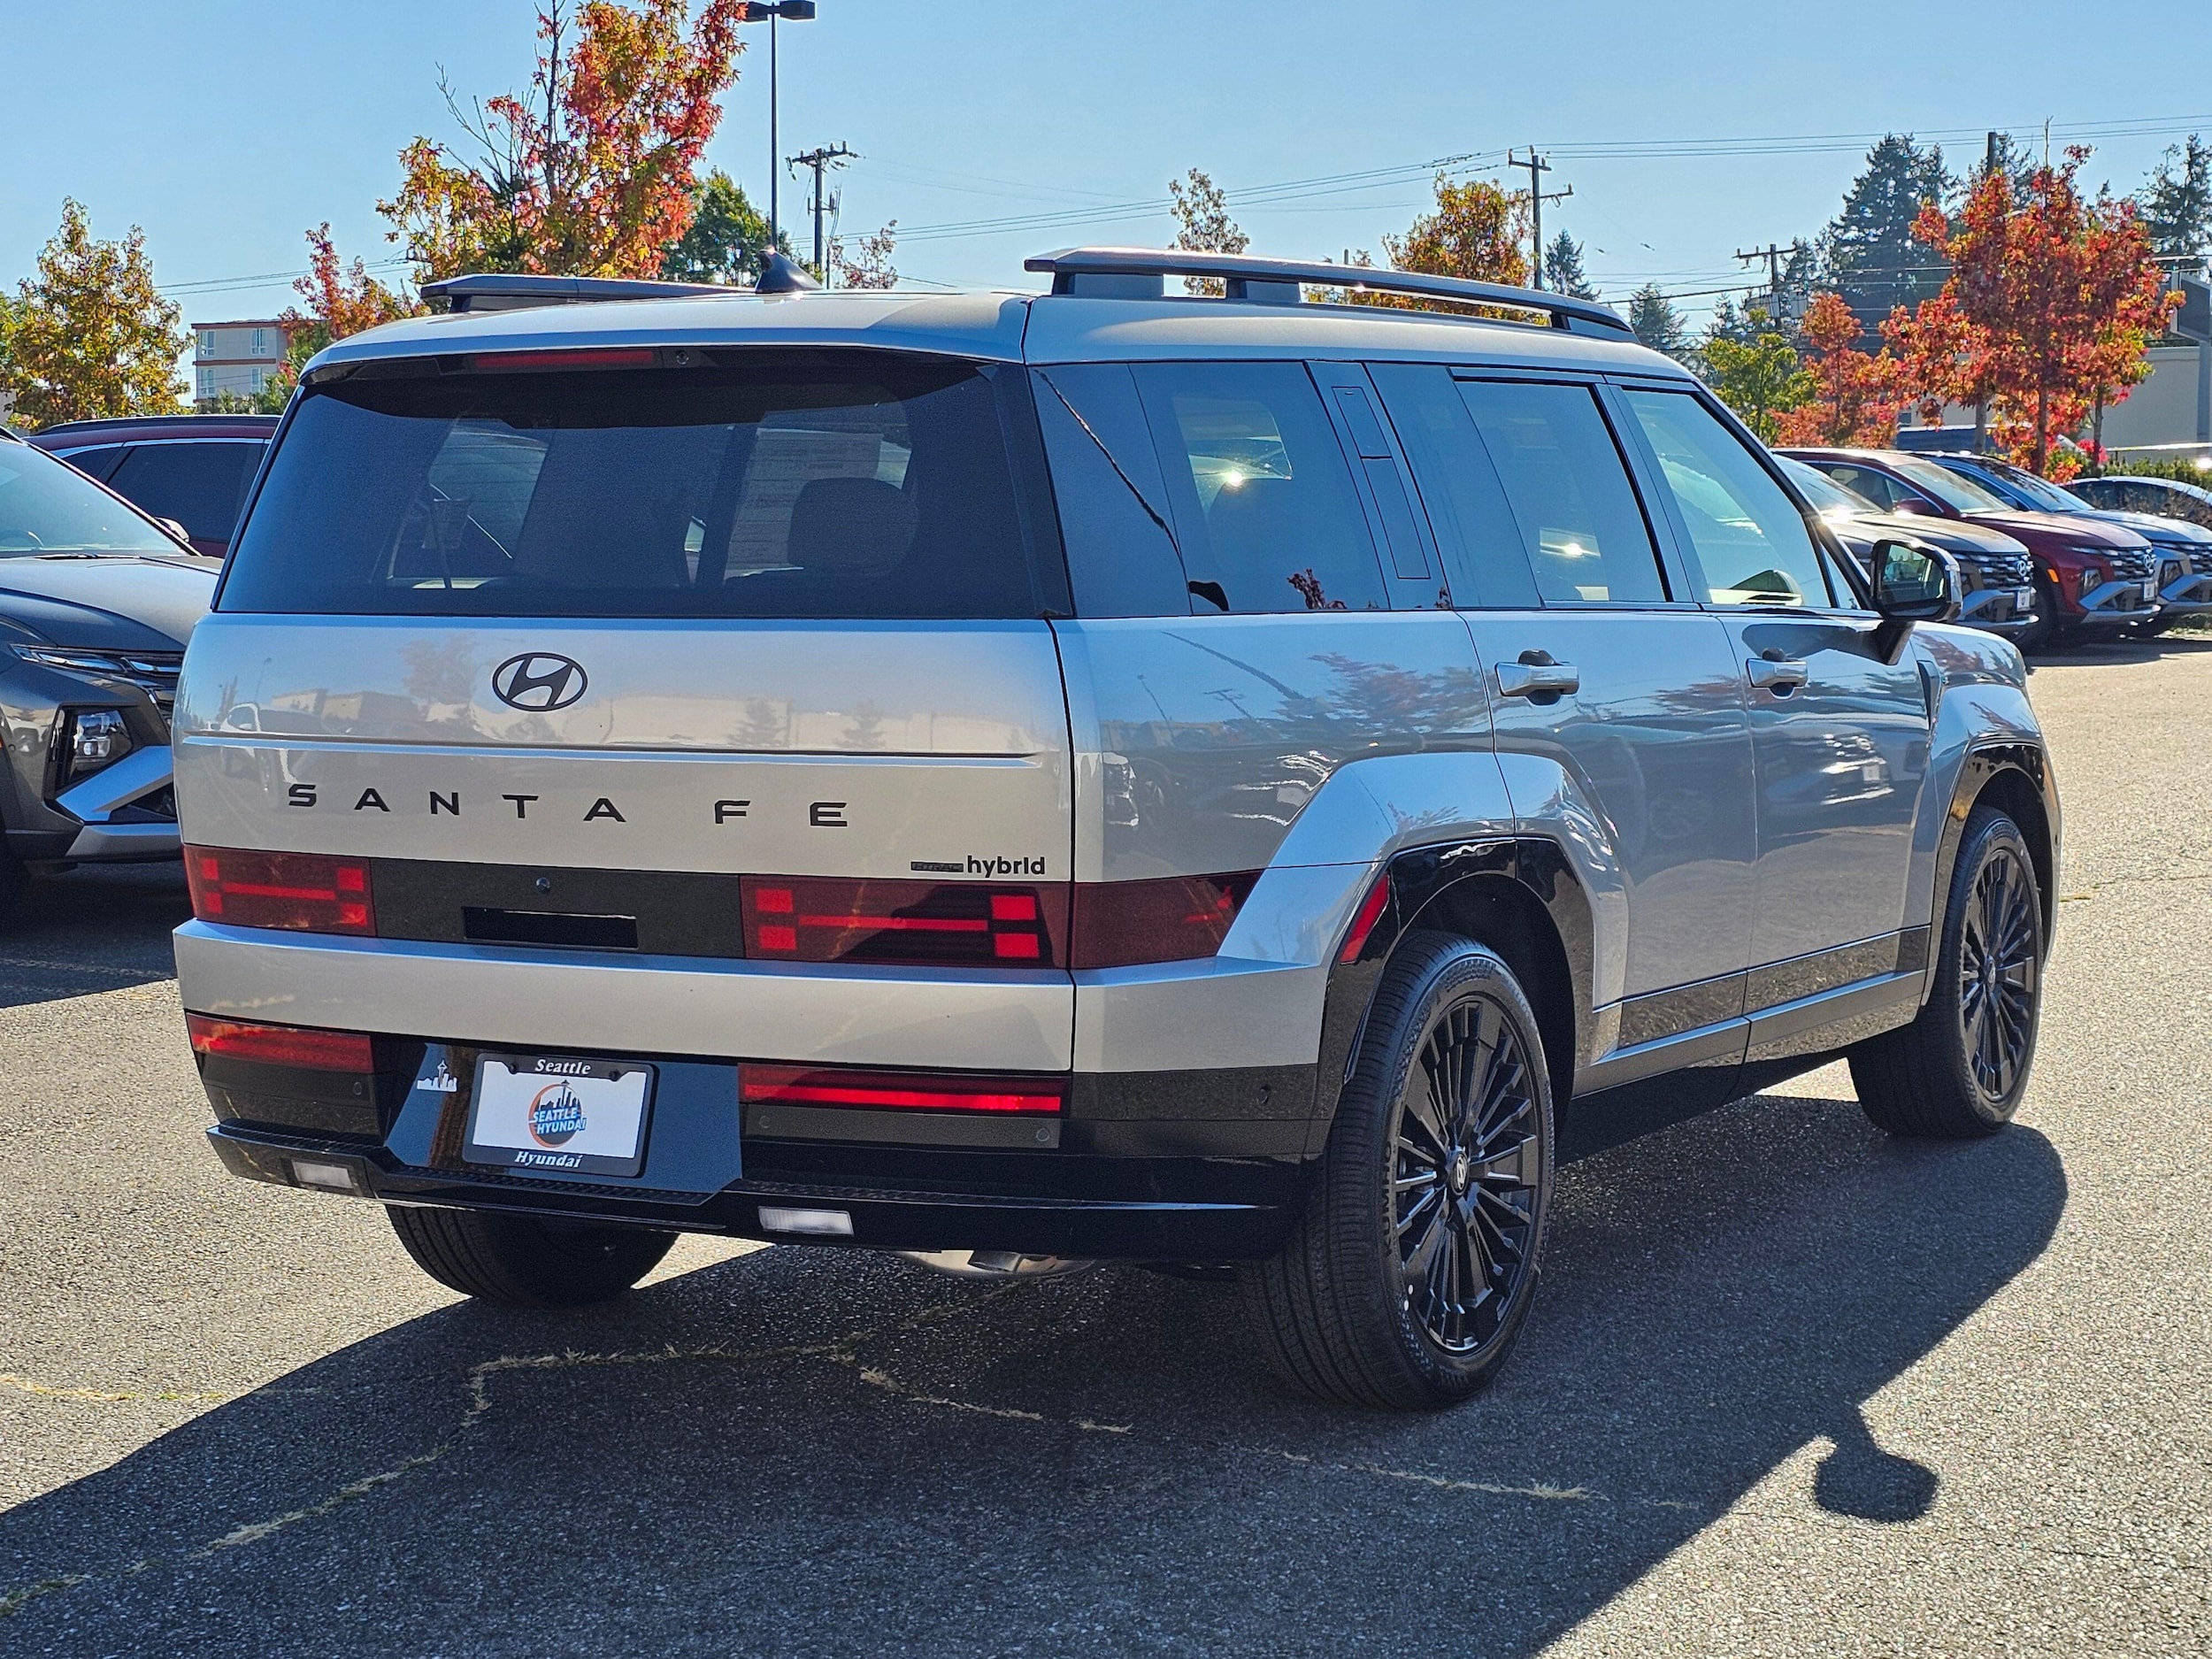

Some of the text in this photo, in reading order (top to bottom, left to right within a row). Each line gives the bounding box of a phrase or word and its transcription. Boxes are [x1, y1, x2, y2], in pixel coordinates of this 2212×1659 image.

[288, 782, 849, 828] SANTA FE
[967, 854, 1047, 879] hybrid
[534, 1058, 592, 1075] Seattle
[533, 1107, 578, 1123] SEATTLE
[536, 1117, 588, 1134] HYUNDAI
[513, 1150, 584, 1168] Hyundai
